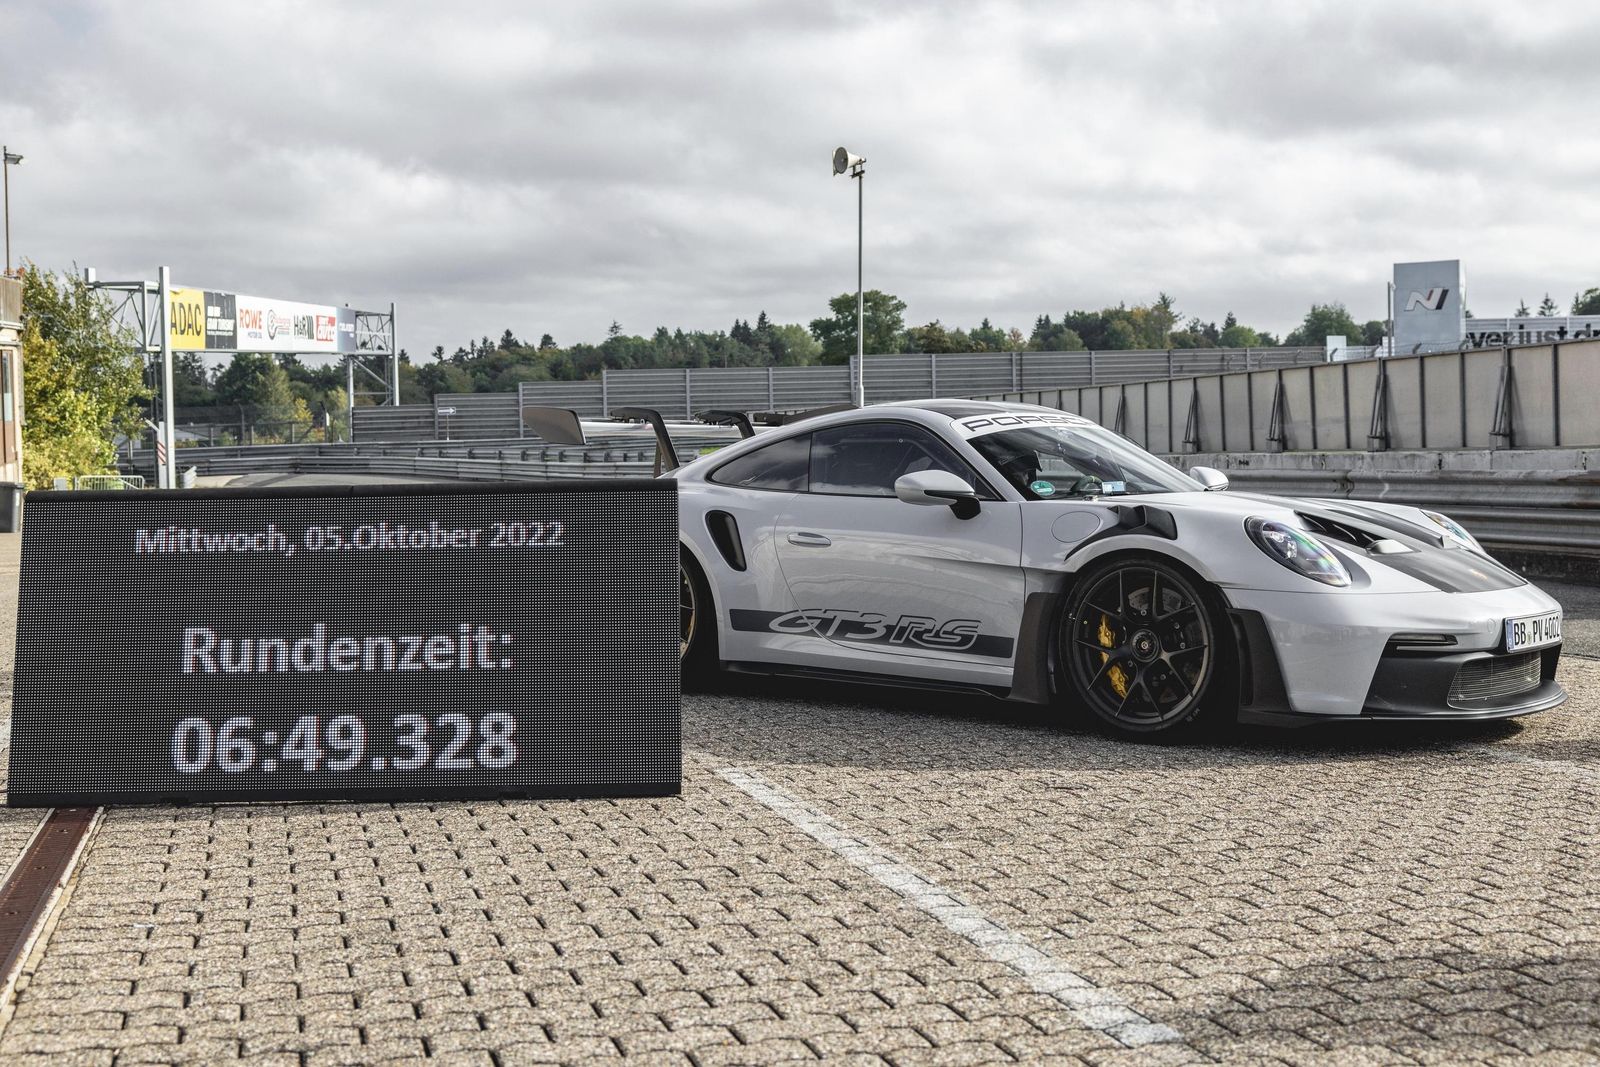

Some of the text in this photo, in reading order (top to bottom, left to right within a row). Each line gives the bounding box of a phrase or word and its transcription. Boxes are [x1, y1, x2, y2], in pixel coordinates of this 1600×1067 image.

[170, 301, 201, 337] ADAC
[240, 308, 263, 329] ROWE
[1465, 331, 1516, 348] ver
[962, 415, 1092, 431] PORSC
[136, 522, 565, 556] Mittwoch, 05.Oktober 2022
[1513, 622, 1526, 646] BB
[1532, 619, 1543, 643] PV
[181, 622, 513, 675] Rundenzeit:
[171, 712, 520, 775] 06:49.328
